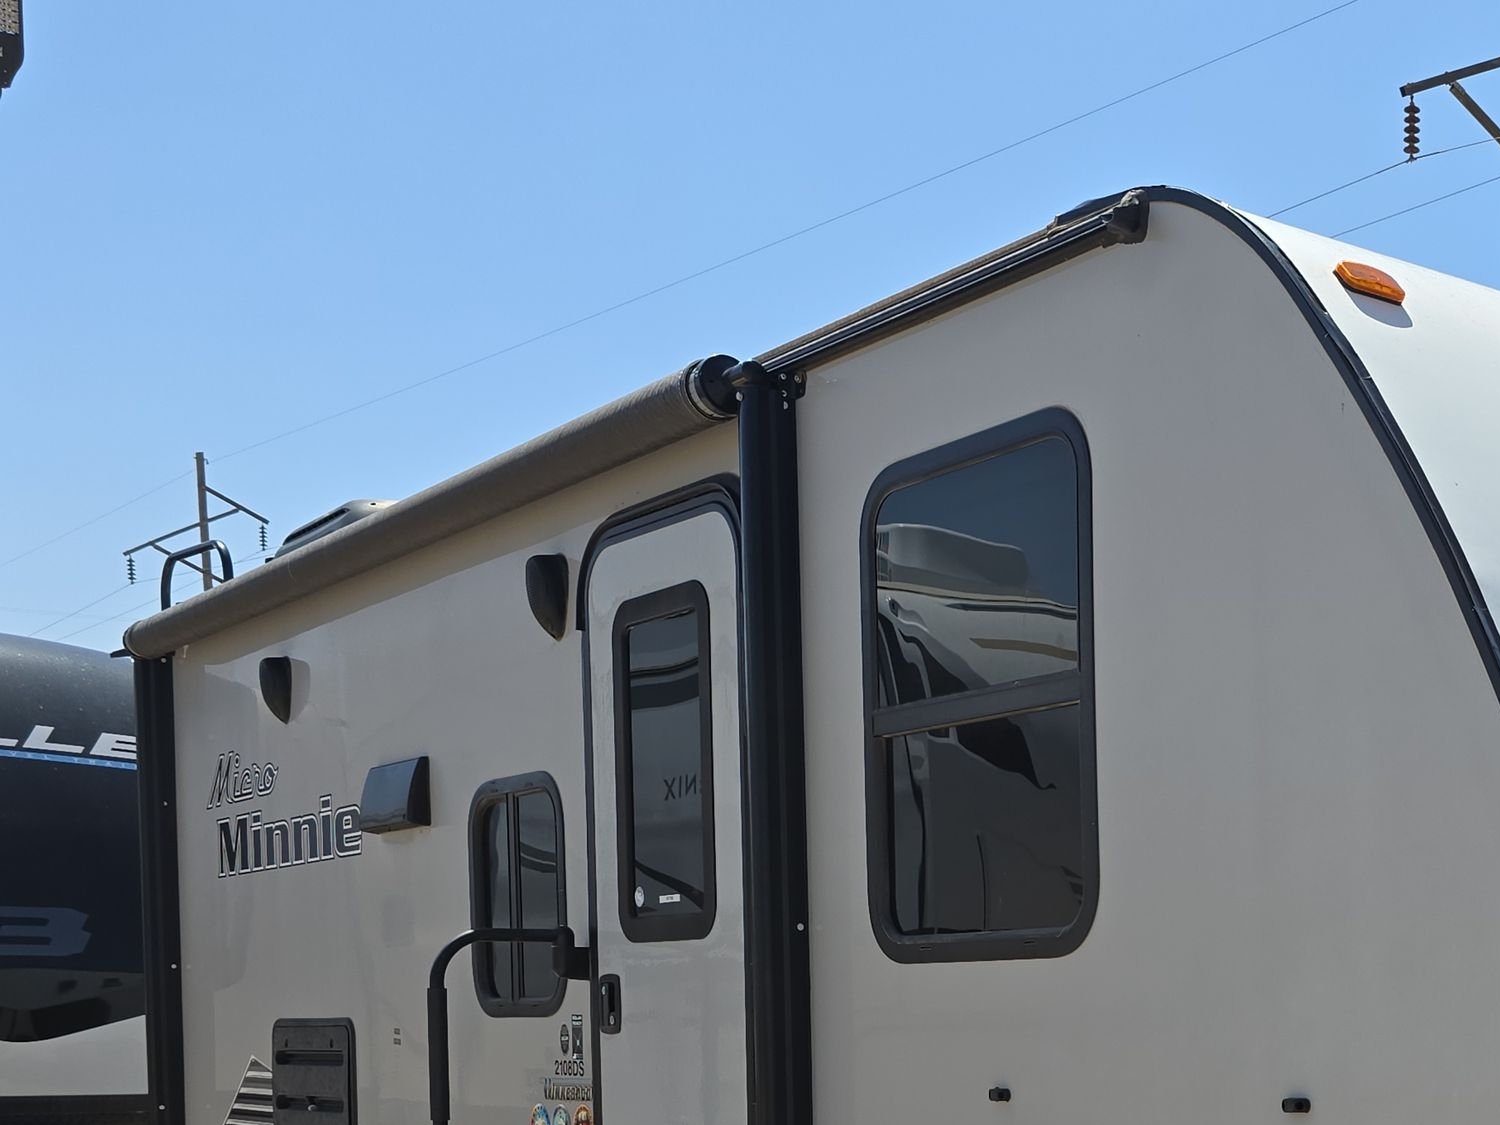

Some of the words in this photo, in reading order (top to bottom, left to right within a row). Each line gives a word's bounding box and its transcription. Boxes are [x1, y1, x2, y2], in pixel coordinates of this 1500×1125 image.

[207, 750, 278, 810] Micro
[216, 794, 362, 878] Minnie
[554, 1059, 585, 1077] 2108DS
